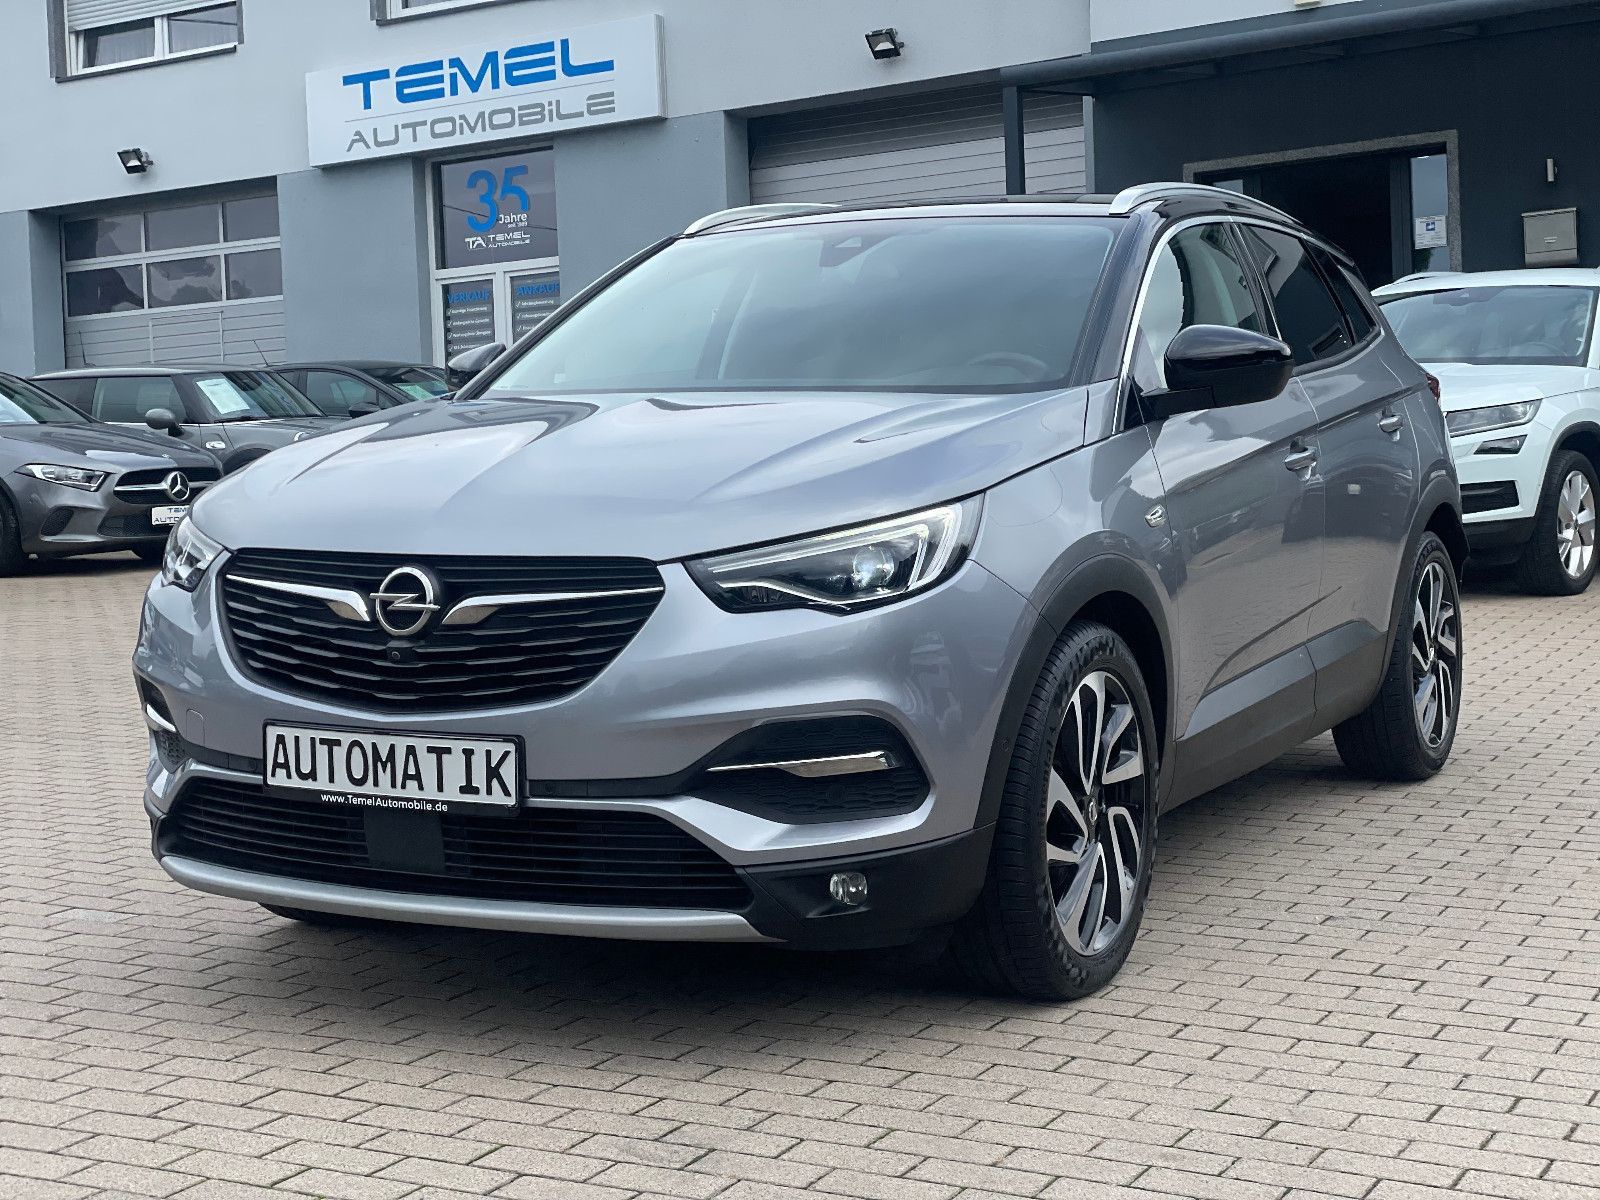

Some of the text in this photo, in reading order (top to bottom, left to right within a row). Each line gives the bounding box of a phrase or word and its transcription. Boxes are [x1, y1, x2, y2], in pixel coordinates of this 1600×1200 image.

[342, 38, 615, 110] TEMEL
[466, 165, 530, 233] 35
[499, 212, 528, 224] Jahre
[488, 231, 531, 243] TEMEL
[448, 288, 490, 304] VERKAUF
[270, 733, 513, 797] AUTOMATIK
[320, 793, 448, 812] www.TemelAutomobile.de
